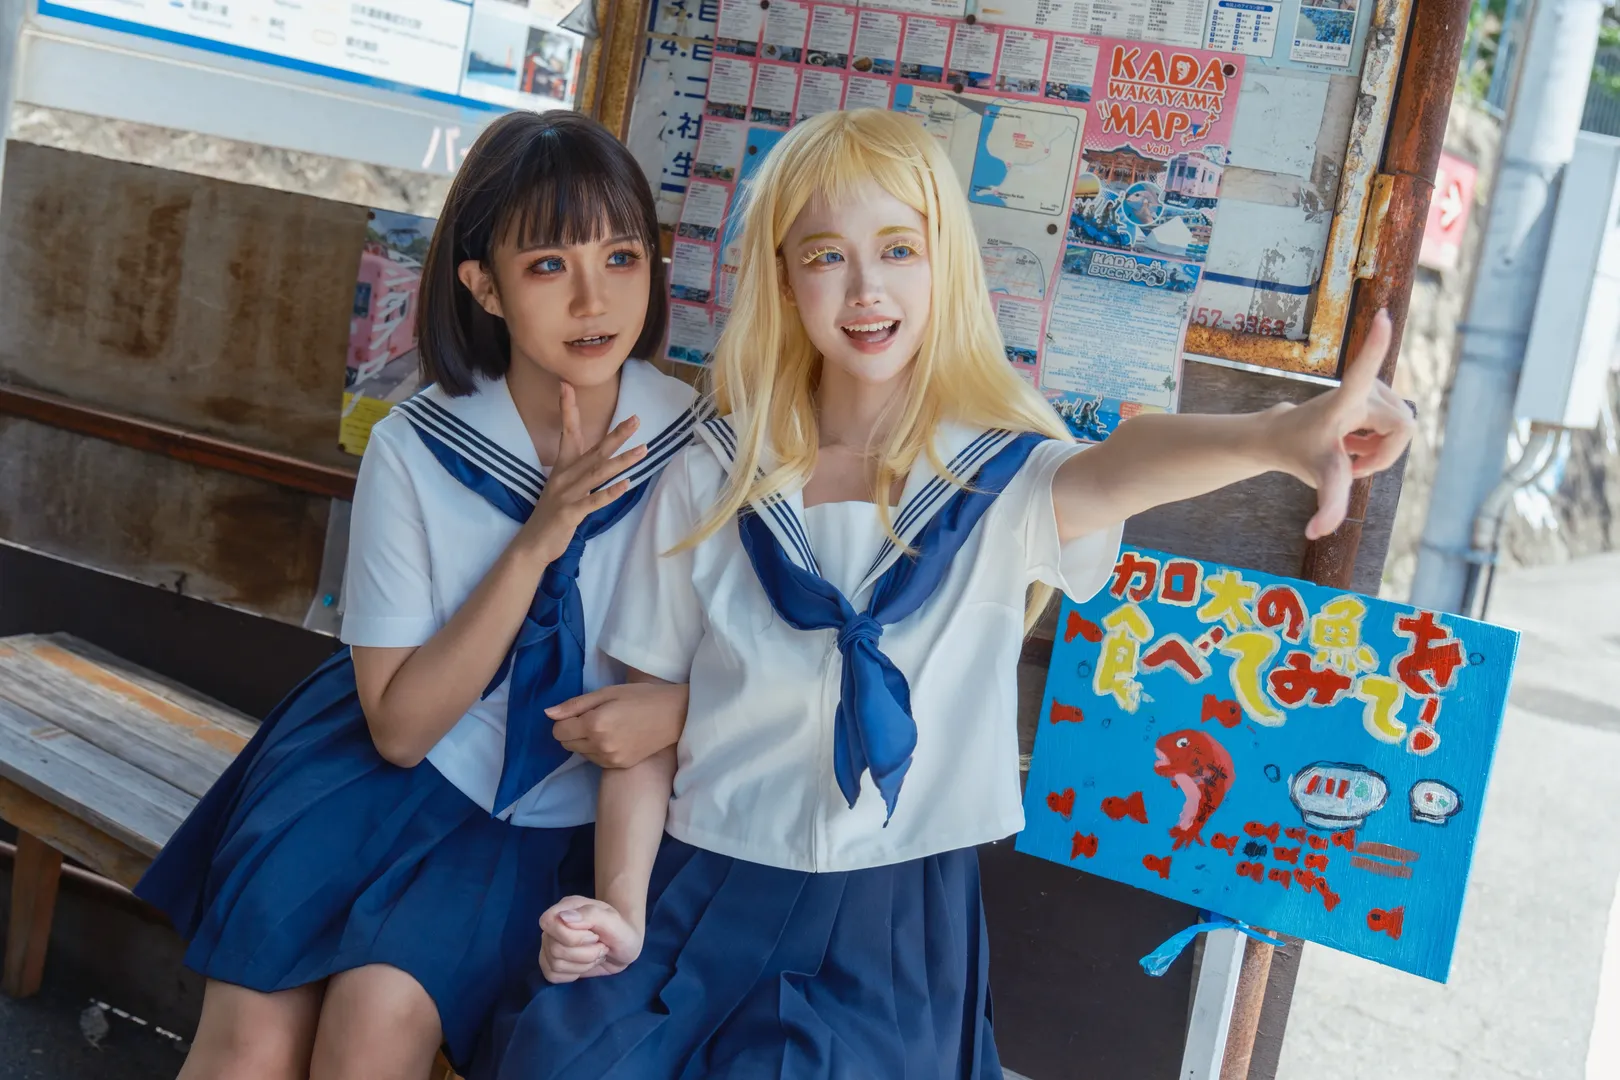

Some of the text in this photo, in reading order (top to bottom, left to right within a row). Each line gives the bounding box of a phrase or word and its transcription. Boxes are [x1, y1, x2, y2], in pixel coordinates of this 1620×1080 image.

[1111, 46, 1226, 93] KADA
[1108, 81, 1222, 112] WAKAYAMA
[1102, 102, 1190, 140] MAP
[1090, 265, 1134, 280] BUGGY
[1094, 253, 1136, 270] KADA
